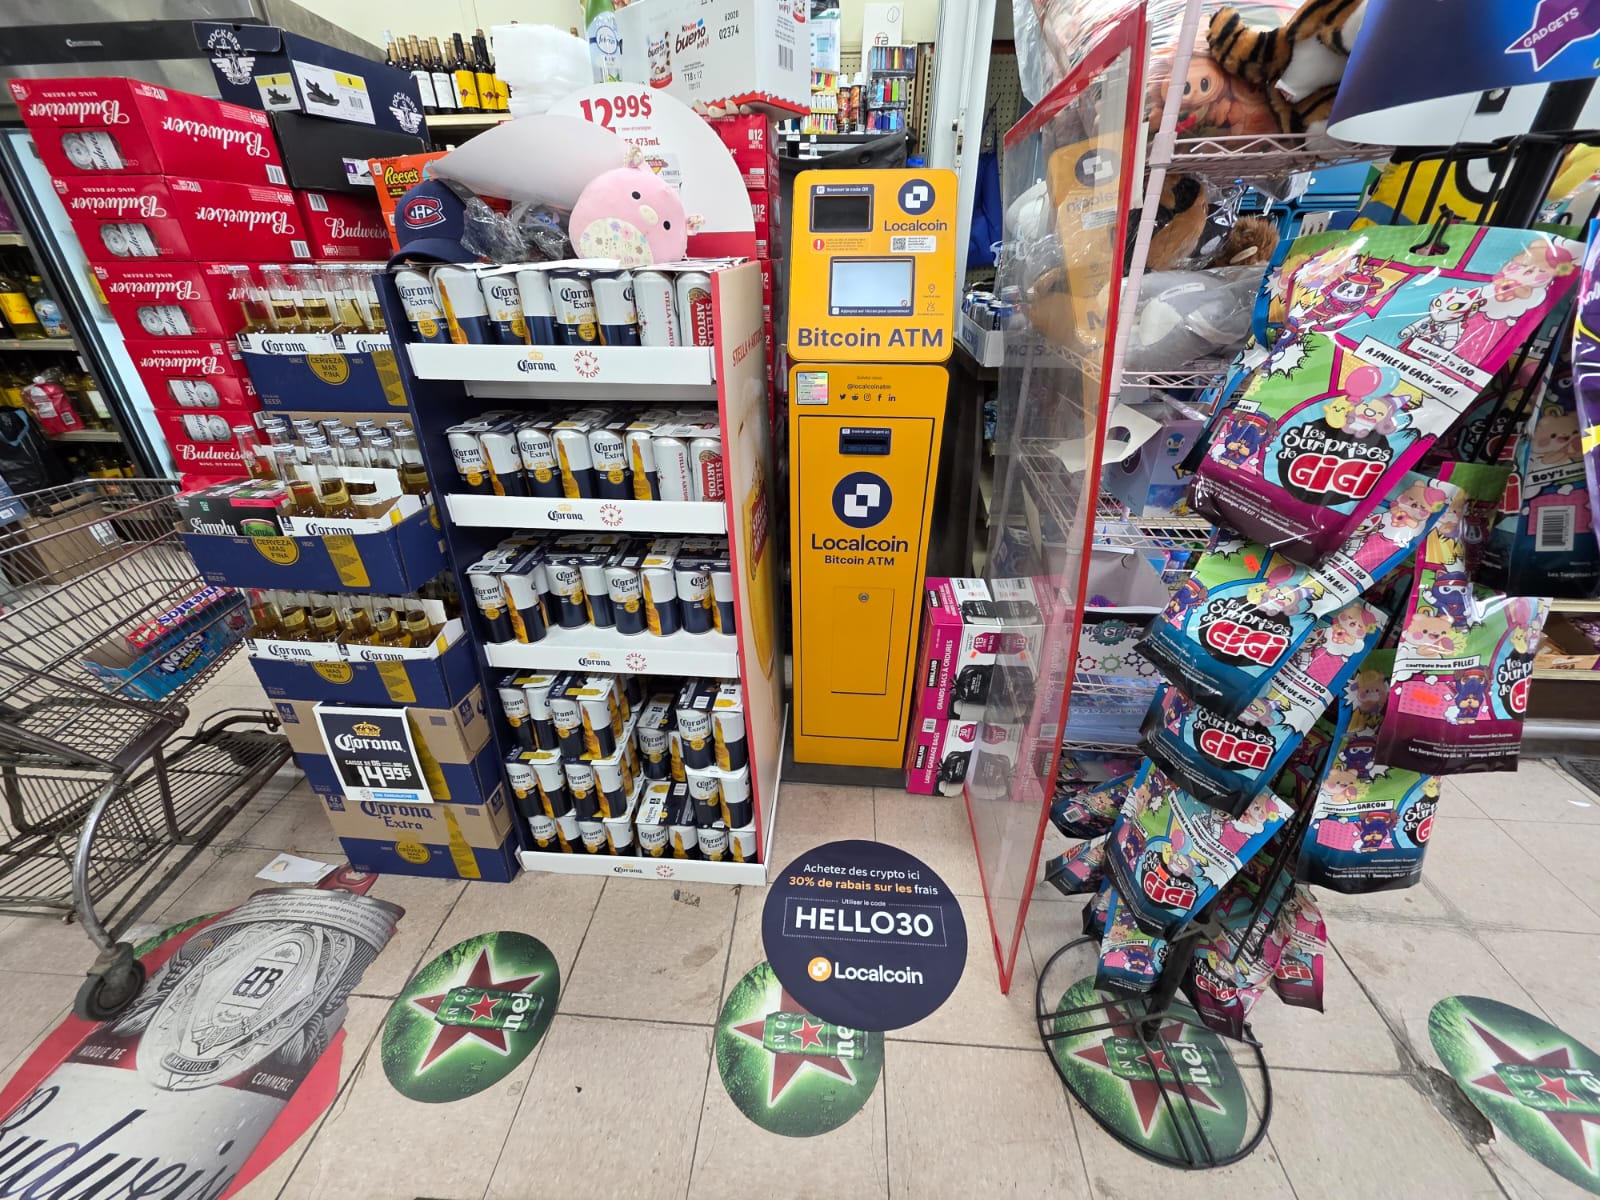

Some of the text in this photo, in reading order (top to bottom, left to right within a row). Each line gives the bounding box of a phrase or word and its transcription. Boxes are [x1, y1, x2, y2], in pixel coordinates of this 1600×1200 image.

[718, 25, 740, 40] 02374
[1522, 8, 1579, 49] GADGETS
[207, 28, 242, 51] DOCKERS
[675, 26, 706, 53] bueno
[28, 100, 130, 124] Budweiser
[392, 92, 418, 113] DOCKERS
[161, 116, 270, 158] Budweiser
[384, 165, 419, 186] Reese's
[72, 196, 167, 218] Budweiser
[196, 207, 295, 234] Budweiser
[324, 217, 390, 239] Budweise
[884, 220, 948, 232] Localcoin
[109, 280, 200, 300] Budweiser
[410, 297, 434, 306] Extra
[696, 302, 708, 346] ARTOIS
[262, 340, 307, 354] Corona
[798, 328, 881, 348] Bitcoin
[887, 328, 944, 348] ATM
[140, 356, 225, 375] Budweiser
[574, 350, 598, 362] STELLA
[1441, 352, 1448, 362] 3
[1456, 364, 1475, 377] 100
[517, 359, 557, 373] Corona
[575, 364, 601, 378] ARTOIS
[1372, 350, 1398, 367] SMILE
[1396, 362, 1408, 372] IN
[1408, 368, 1433, 385] EACH
[1302, 424, 1326, 439] Les
[1278, 447, 1297, 460] de
[1284, 428, 1392, 461] Surprises
[706, 462, 716, 498] ARTOIS
[715, 462, 724, 497] STELLA
[548, 510, 584, 522] Corona
[600, 504, 622, 515] STELLA
[190, 516, 238, 536] Simply
[306, 521, 354, 536] Corona
[601, 516, 624, 527] ARTOIS
[255, 538, 292, 547] CERVEZA
[811, 534, 908, 553] Localcoin
[824, 556, 895, 566] Bitcoin ATM
[1210, 600, 1290, 636] Surprises
[268, 644, 312, 656] Corona
[974, 637, 983, 648] 113
[360, 650, 404, 662] Corona
[578, 658, 611, 667] Corona
[943, 640, 953, 667] ORDURES
[928, 660, 938, 687] KIRKLAND
[1506, 659, 1521, 670] Les
[940, 673, 948, 688] SACS
[1272, 676, 1298, 698] CHAQUE
[1312, 683, 1326, 694] 100
[1500, 684, 1511, 696] de
[936, 688, 946, 710] GRANDS
[960, 728, 968, 737] 30
[1198, 706, 1274, 746] Surprises
[334, 734, 406, 753] Corona
[916, 746, 926, 768] KIRKLAND
[924, 732, 940, 784] LARGE GARBAGE BAGS
[360, 801, 433, 819] Corona
[1357, 802, 1386, 810] GARÇON
[384, 816, 424, 830] Extra
[804, 864, 920, 880] Achetez des crypto ici
[788, 876, 938, 896] 30% de rabais sur les frais
[795, 906, 934, 937] HELLO30
[834, 962, 924, 984] Localcoin
[110, 1048, 127, 1060] DE
[252, 1071, 294, 1092] COMMERCE
